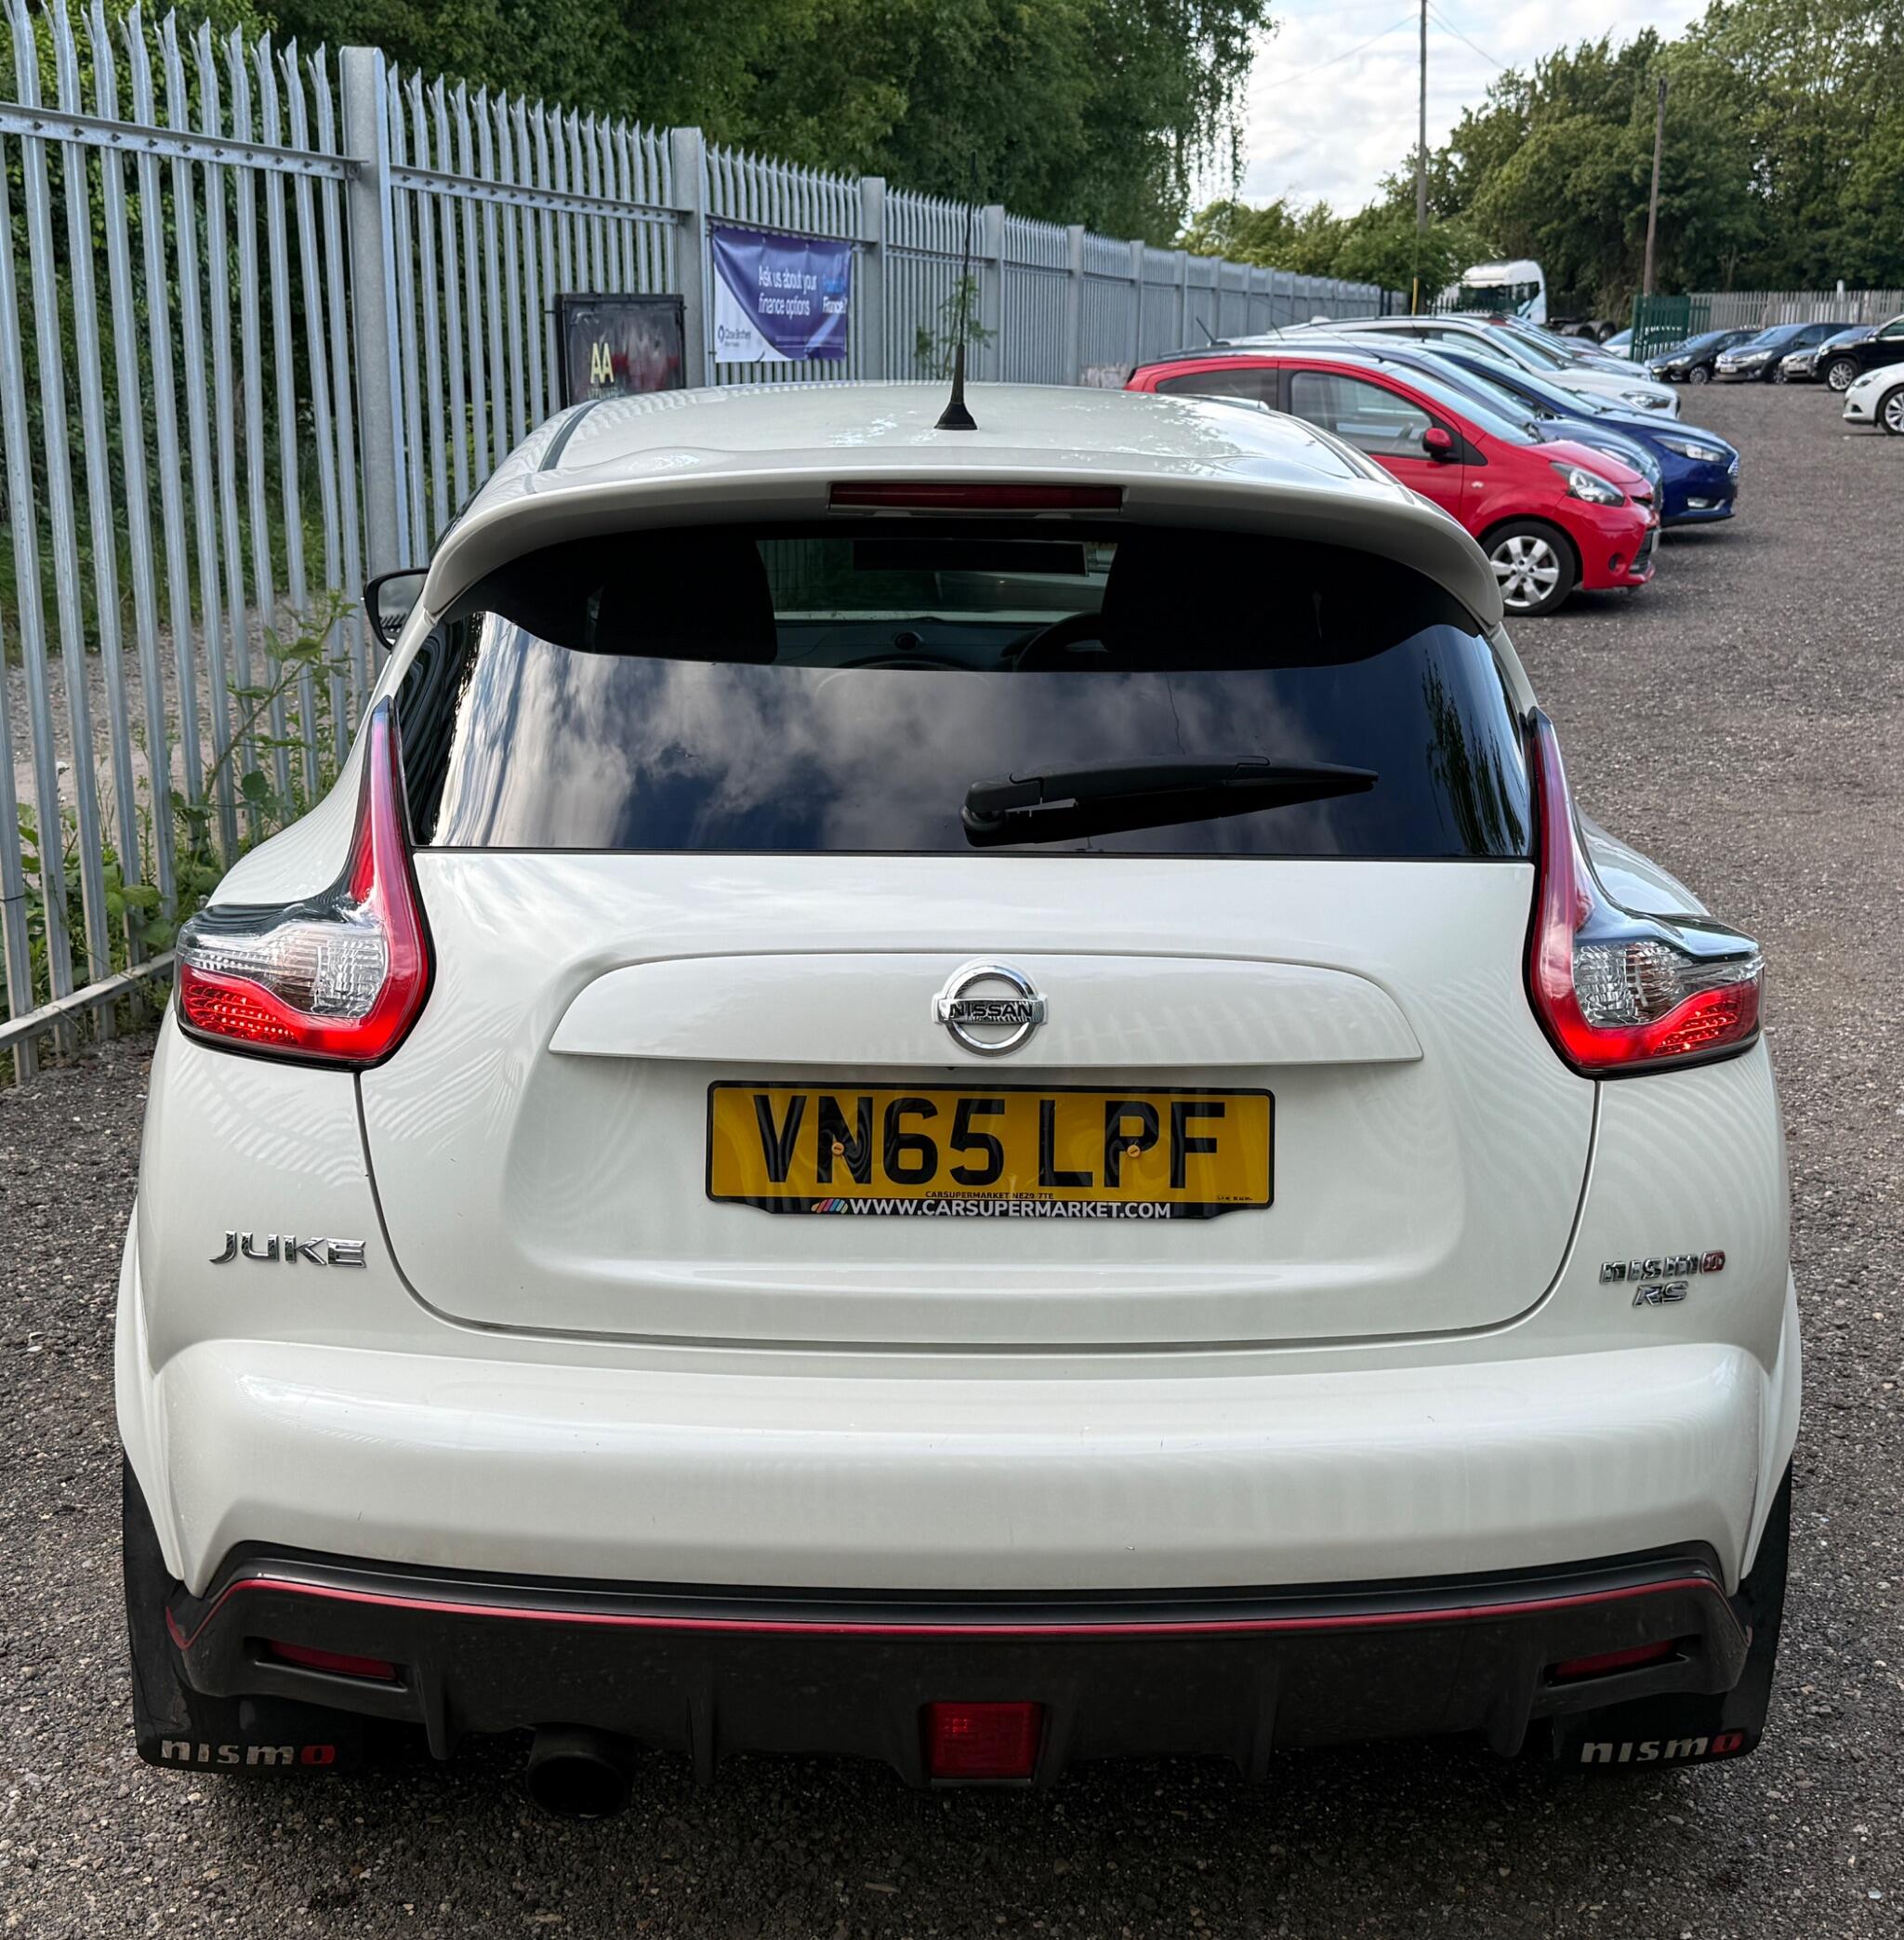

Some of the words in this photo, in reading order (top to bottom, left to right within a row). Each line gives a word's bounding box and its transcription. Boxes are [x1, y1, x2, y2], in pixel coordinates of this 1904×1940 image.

[759, 265, 774, 287] Ask
[773, 271, 782, 288] us
[783, 268, 802, 290] about
[802, 274, 817, 295] your
[758, 292, 785, 315] finance
[785, 295, 811, 320] options
[589, 342, 614, 384] AA
[949, 1003, 1033, 1017] NISSAN
[753, 1094, 1005, 1187] VN65
[1038, 1099, 1226, 1189] LPF
[850, 1198, 1171, 1220] WWW.CARSUPERMARKET.COM
[925, 1191, 1011, 1199] CARSUPERMARKET
[208, 1230, 367, 1268] JUKE
[1633, 1280, 1688, 1308] RS
[161, 1739, 336, 1765] nismo
[1580, 1733, 1744, 1762] nismo
